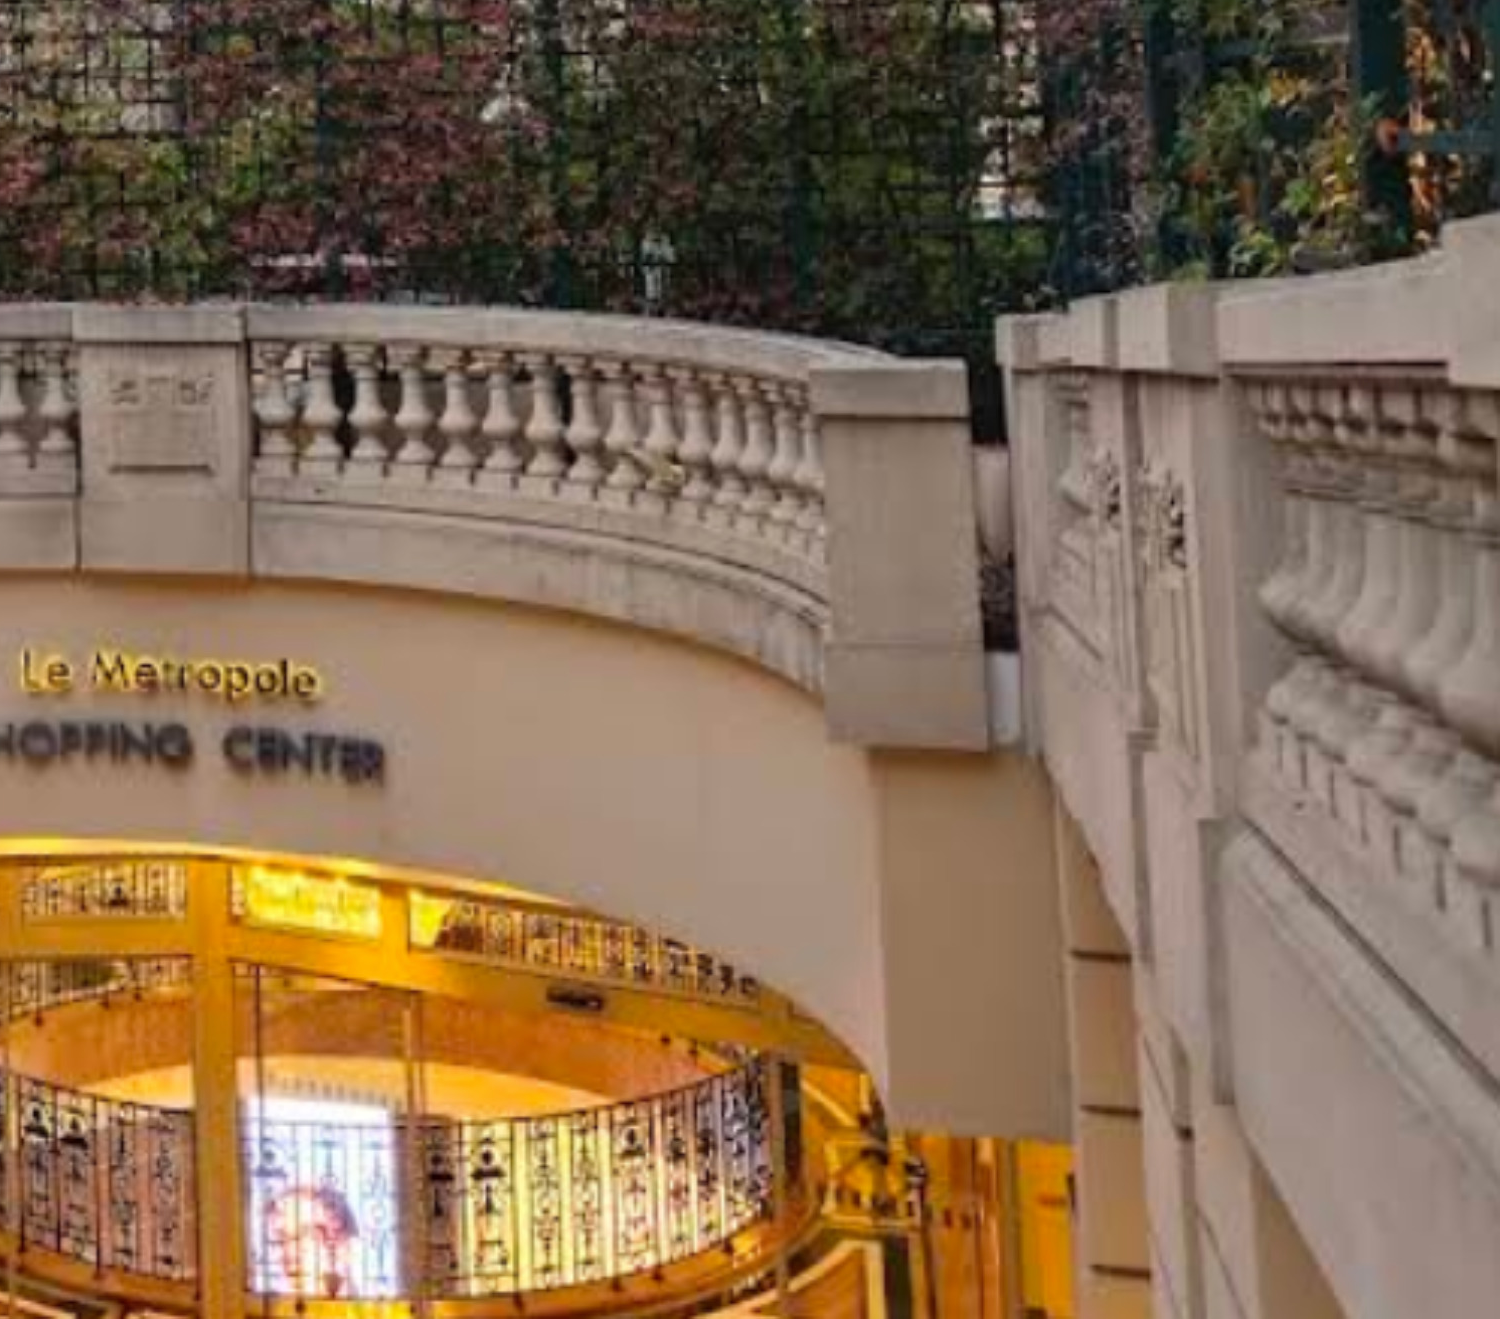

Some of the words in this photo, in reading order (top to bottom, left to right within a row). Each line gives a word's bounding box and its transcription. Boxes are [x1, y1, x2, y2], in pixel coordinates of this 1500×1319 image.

[20, 648, 72, 692] Le
[94, 650, 322, 702] Metropole
[221, 725, 388, 784] CENTER
